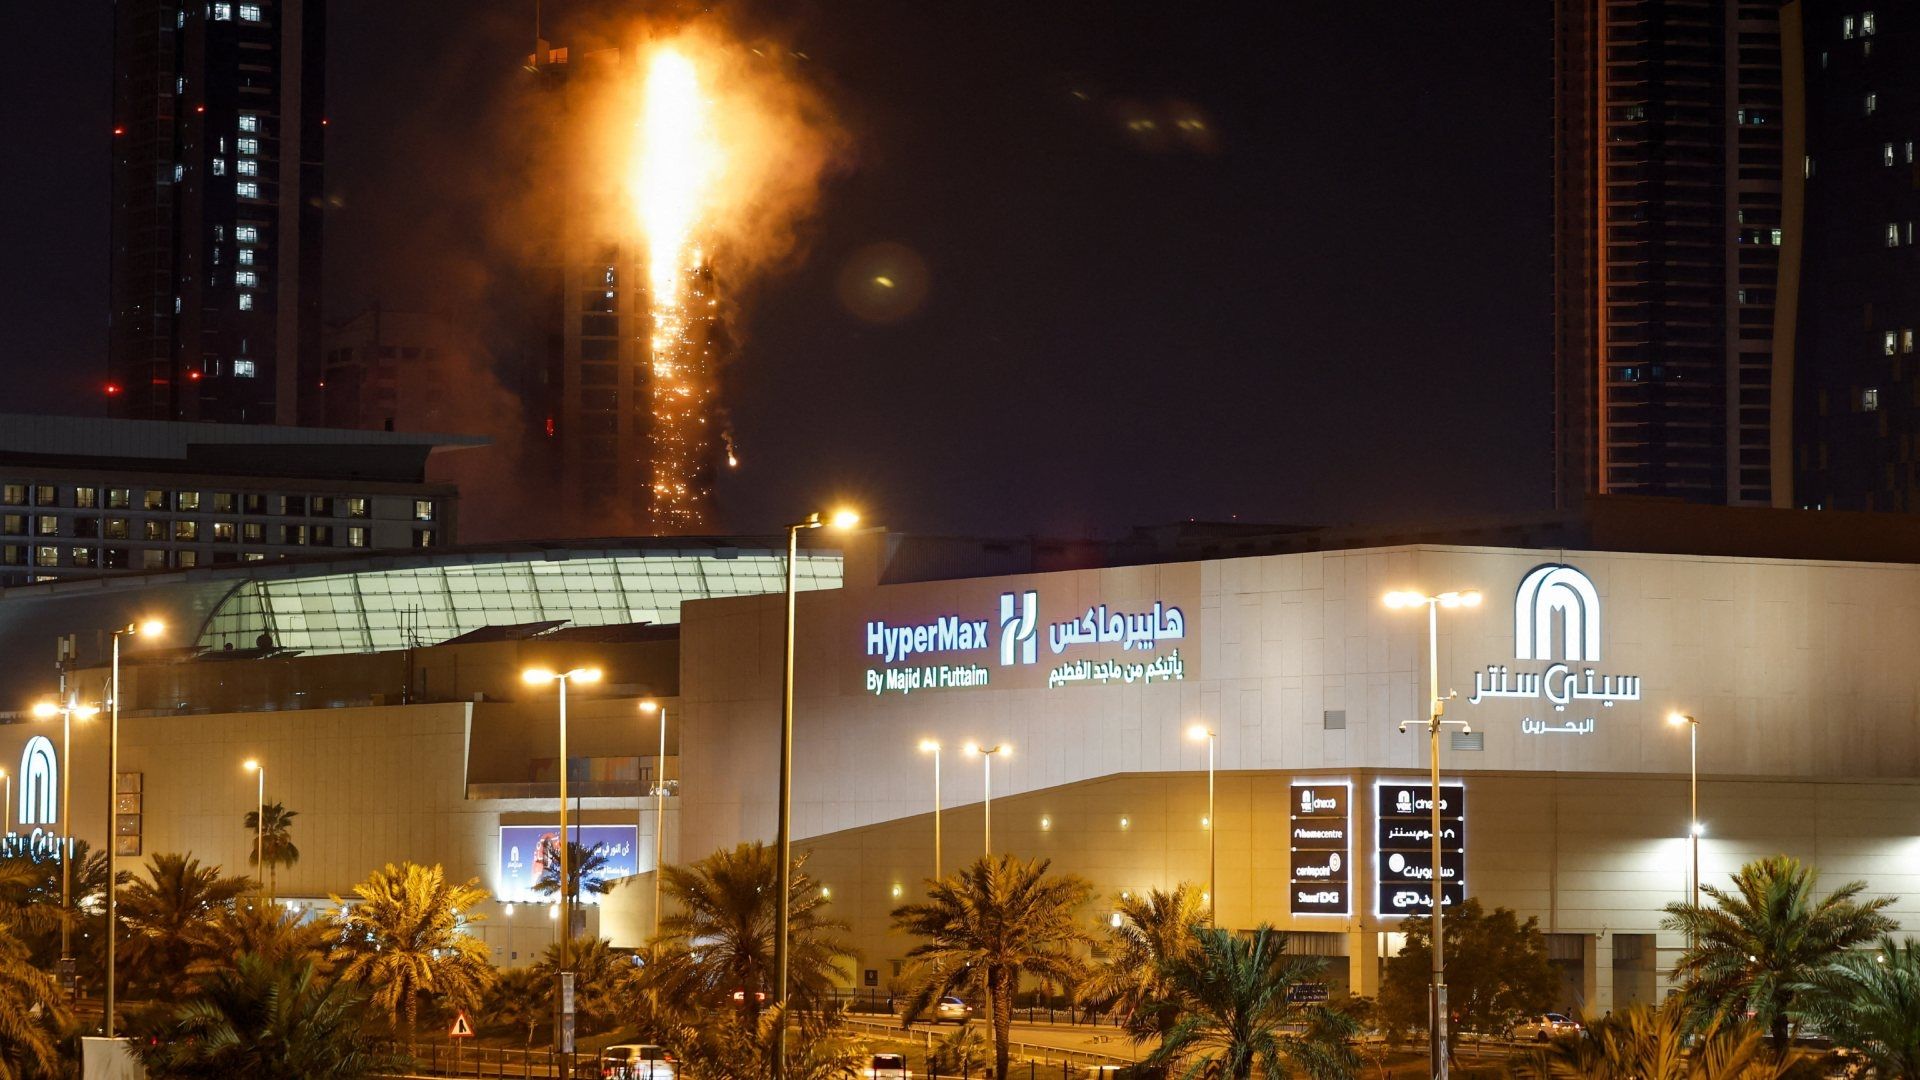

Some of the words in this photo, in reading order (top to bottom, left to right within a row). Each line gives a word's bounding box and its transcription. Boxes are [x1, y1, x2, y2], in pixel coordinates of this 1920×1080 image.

[867, 616, 988, 663] HyperMax
[1049, 602, 1184, 654] هايبرماكس
[866, 669, 884, 696] By
[886, 667, 920, 695] Majid
[922, 666, 937, 688] Al
[939, 664, 988, 688] Futtaim
[1048, 660, 1092, 690] الفطيم
[1093, 659, 1123, 685] ماجد
[1124, 664, 1145, 684] من
[1468, 665, 1540, 705] سنتر
[1543, 663, 1641, 712] سيتي
[1522, 717, 1594, 736] البحرين
